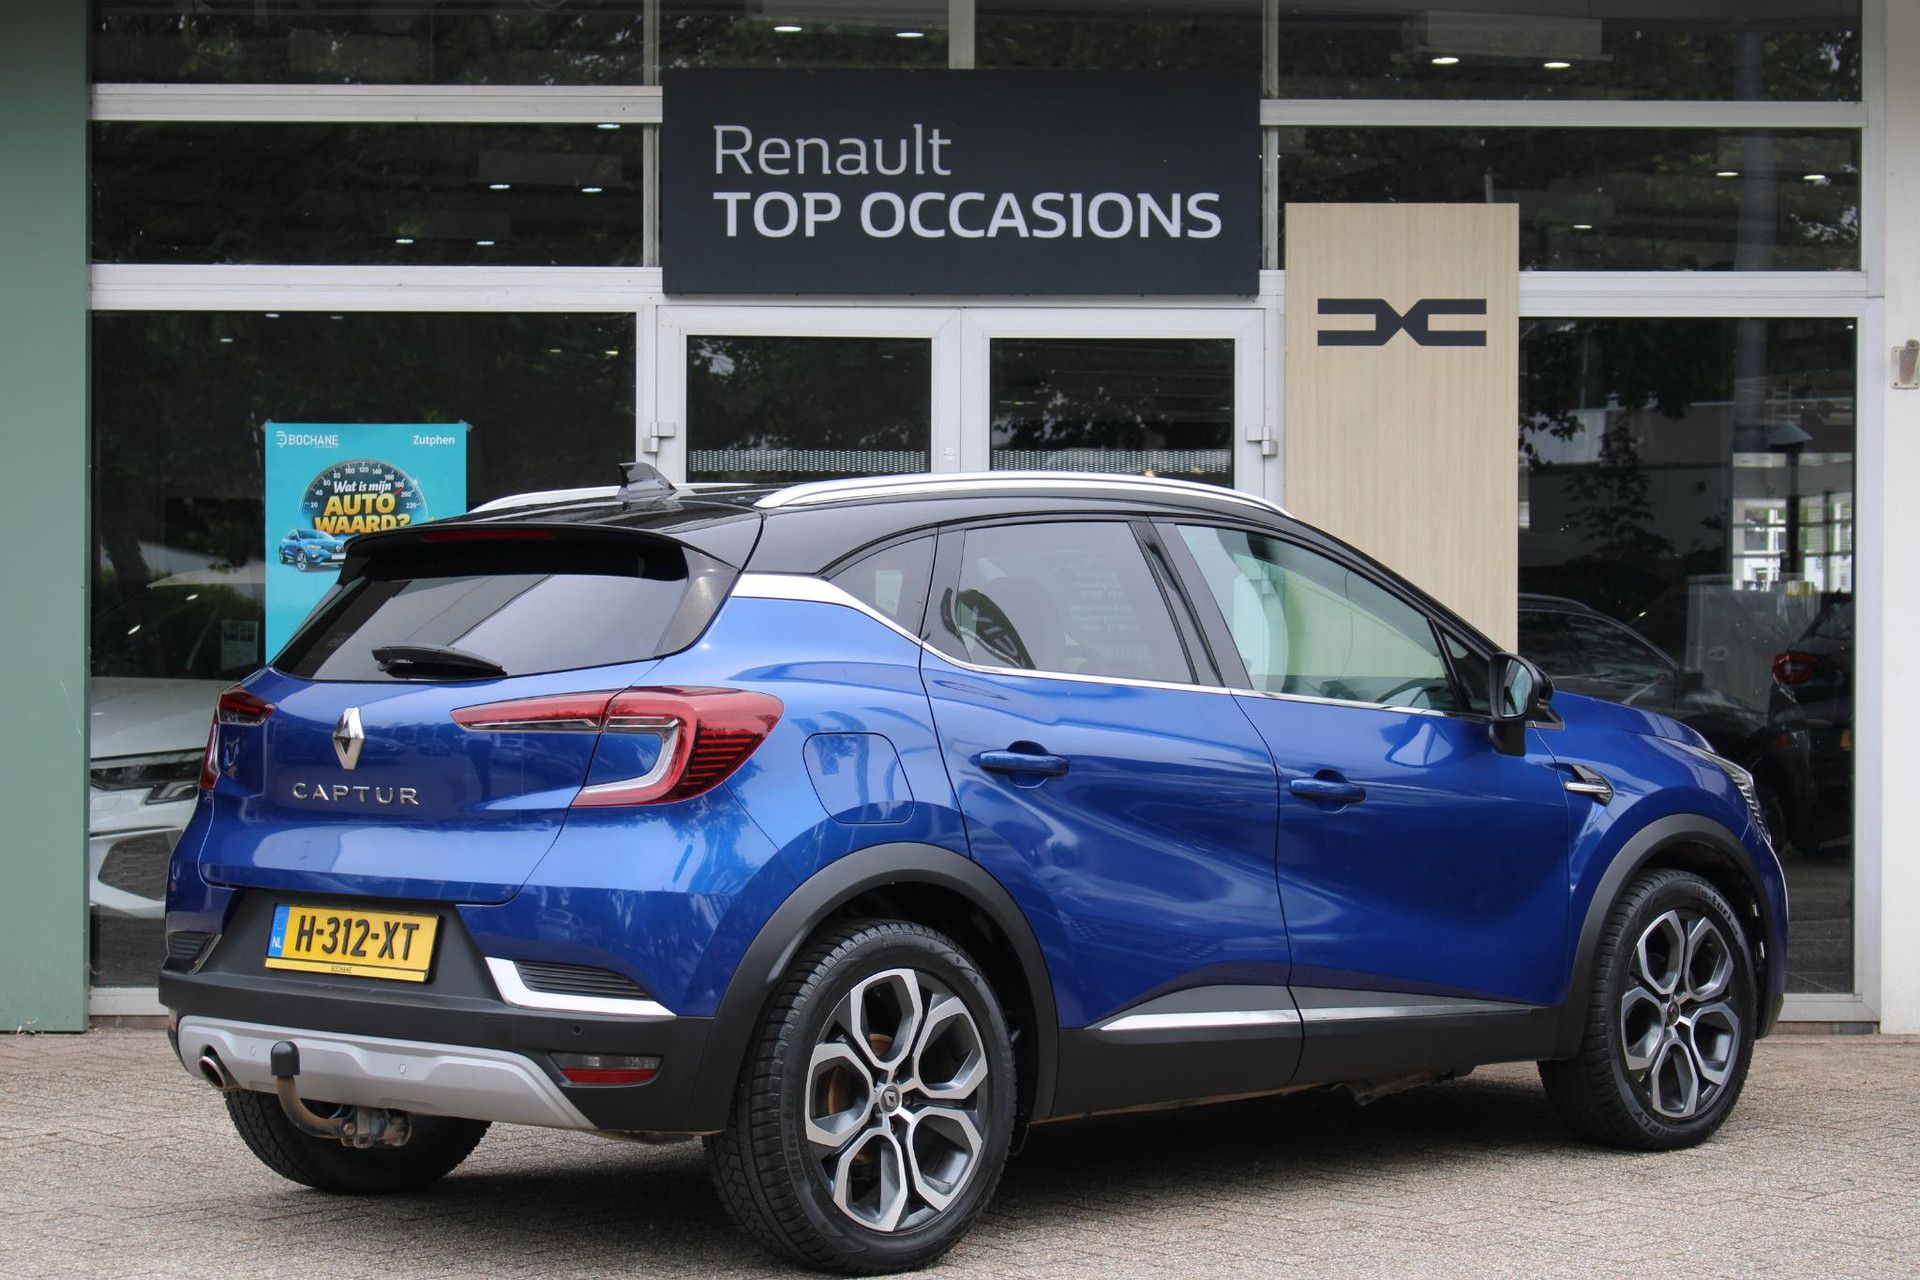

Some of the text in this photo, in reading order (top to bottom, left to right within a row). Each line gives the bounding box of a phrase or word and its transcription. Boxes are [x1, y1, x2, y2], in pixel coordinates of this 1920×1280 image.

[714, 124, 952, 176] Renault
[713, 191, 1222, 239] TOP OCCASIONS
[288, 434, 339, 446] BOCHANE
[413, 435, 455, 447] Zutphen
[333, 480, 392, 494] Wat is mijn
[323, 494, 396, 516] AUTO
[314, 513, 410, 535] WAARD?
[292, 782, 420, 806] CAPTUR
[271, 936, 282, 948] NL
[295, 914, 420, 961] H-312-XT
